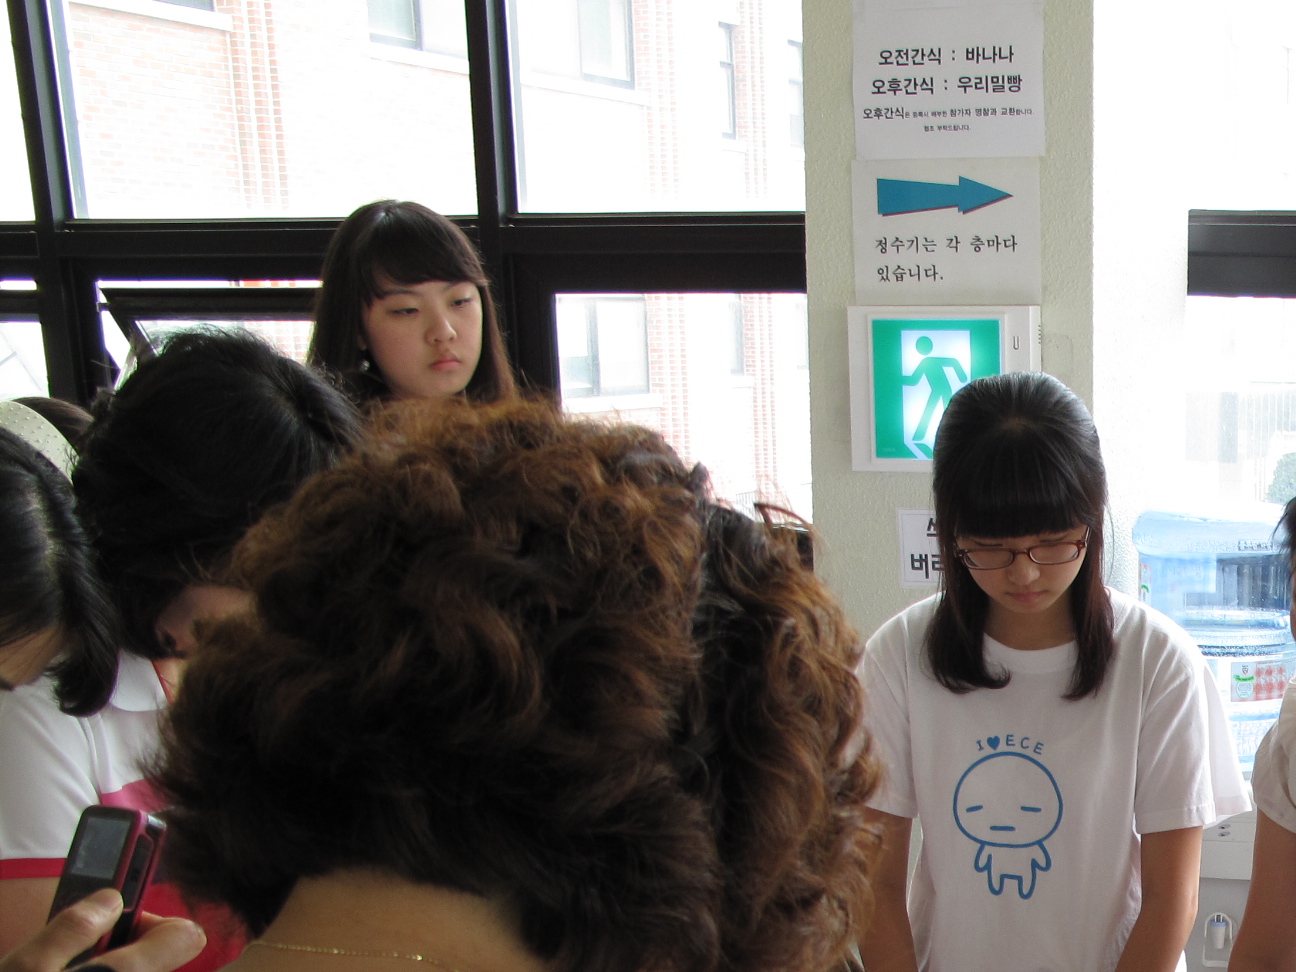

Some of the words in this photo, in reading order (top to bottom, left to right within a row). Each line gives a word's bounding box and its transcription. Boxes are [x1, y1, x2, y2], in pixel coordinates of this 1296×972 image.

[878, 47, 942, 66] 오전간식
[965, 45, 1015, 64] 바나나
[871, 77, 935, 96] 오후간식
[957, 74, 1023, 94] 우리밀빵
[863, 106, 911, 120] 오후간식은
[950, 107, 972, 118] 참가자
[875, 236, 937, 254] 정수기는
[946, 235, 961, 253] 각
[970, 234, 1018, 253] 층마다
[877, 264, 944, 283] 있습니다.
[1005, 734, 1044, 755] ECE
